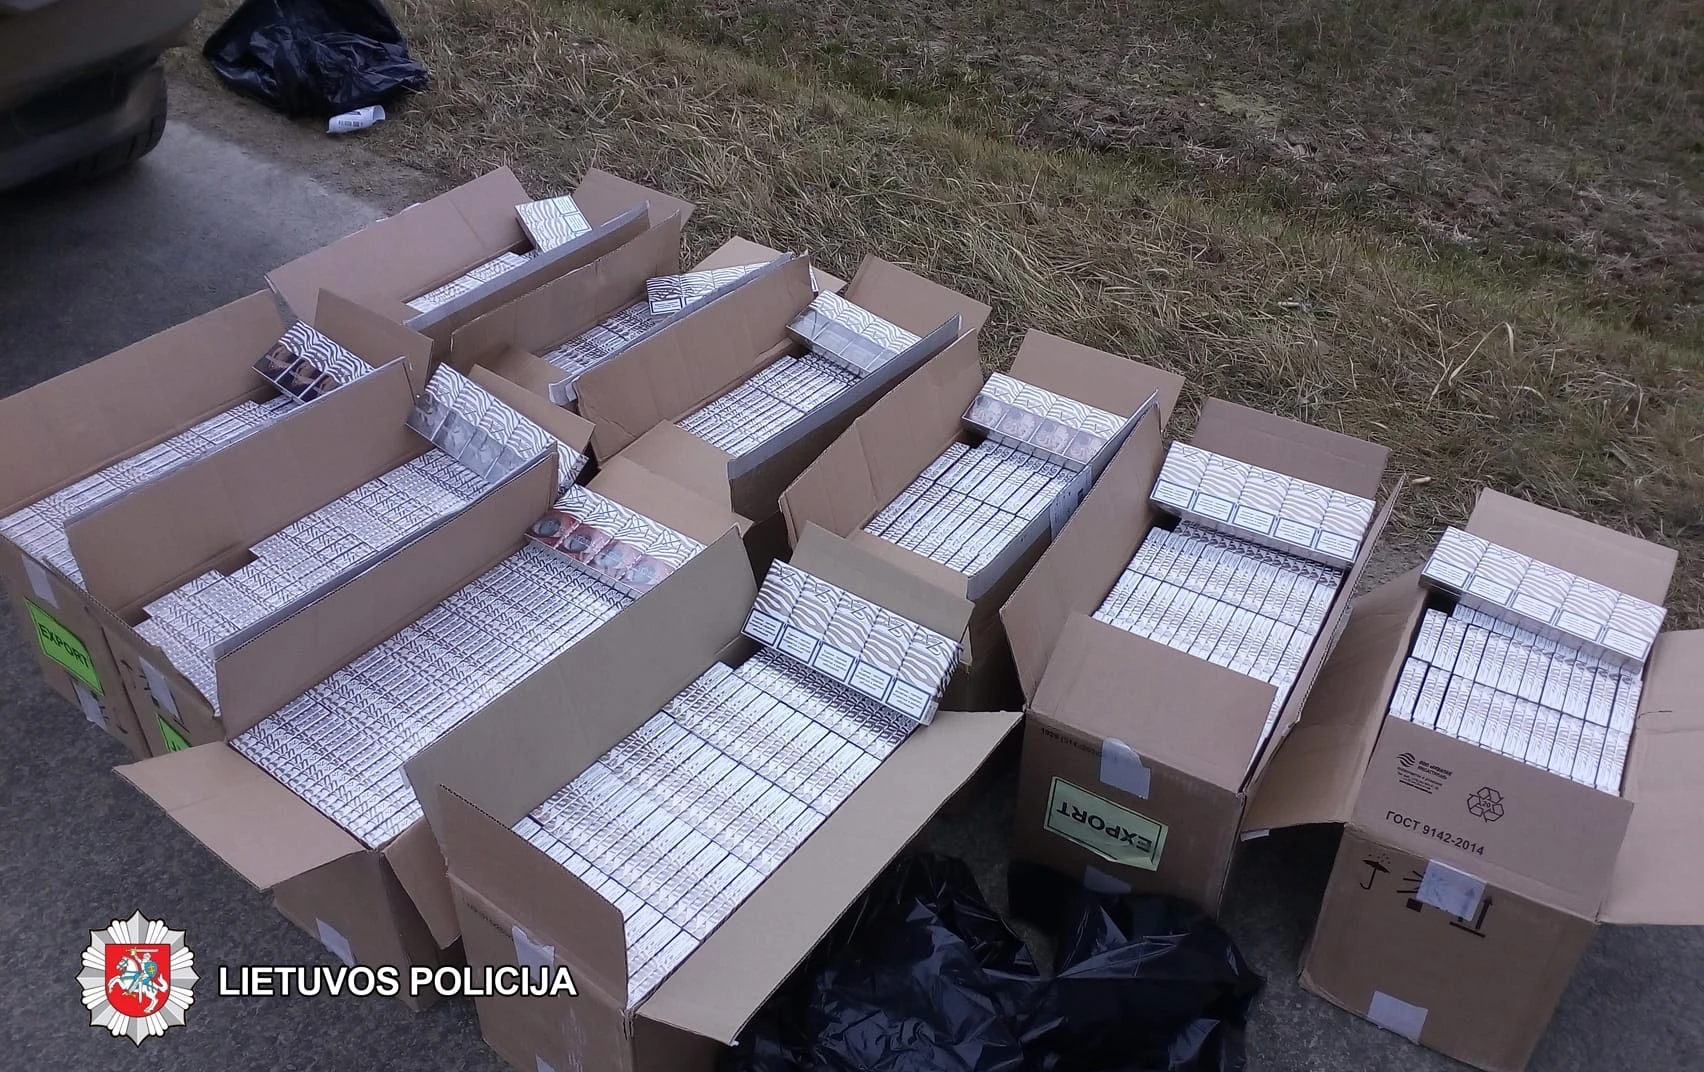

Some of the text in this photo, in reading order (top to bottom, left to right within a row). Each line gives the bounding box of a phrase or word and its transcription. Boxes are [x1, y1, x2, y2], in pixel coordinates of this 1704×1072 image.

[38, 623, 89, 668] EXPORT
[1057, 802, 1153, 853] EXPORT
[1386, 810, 1485, 856] ГОСТ 9142-2014
